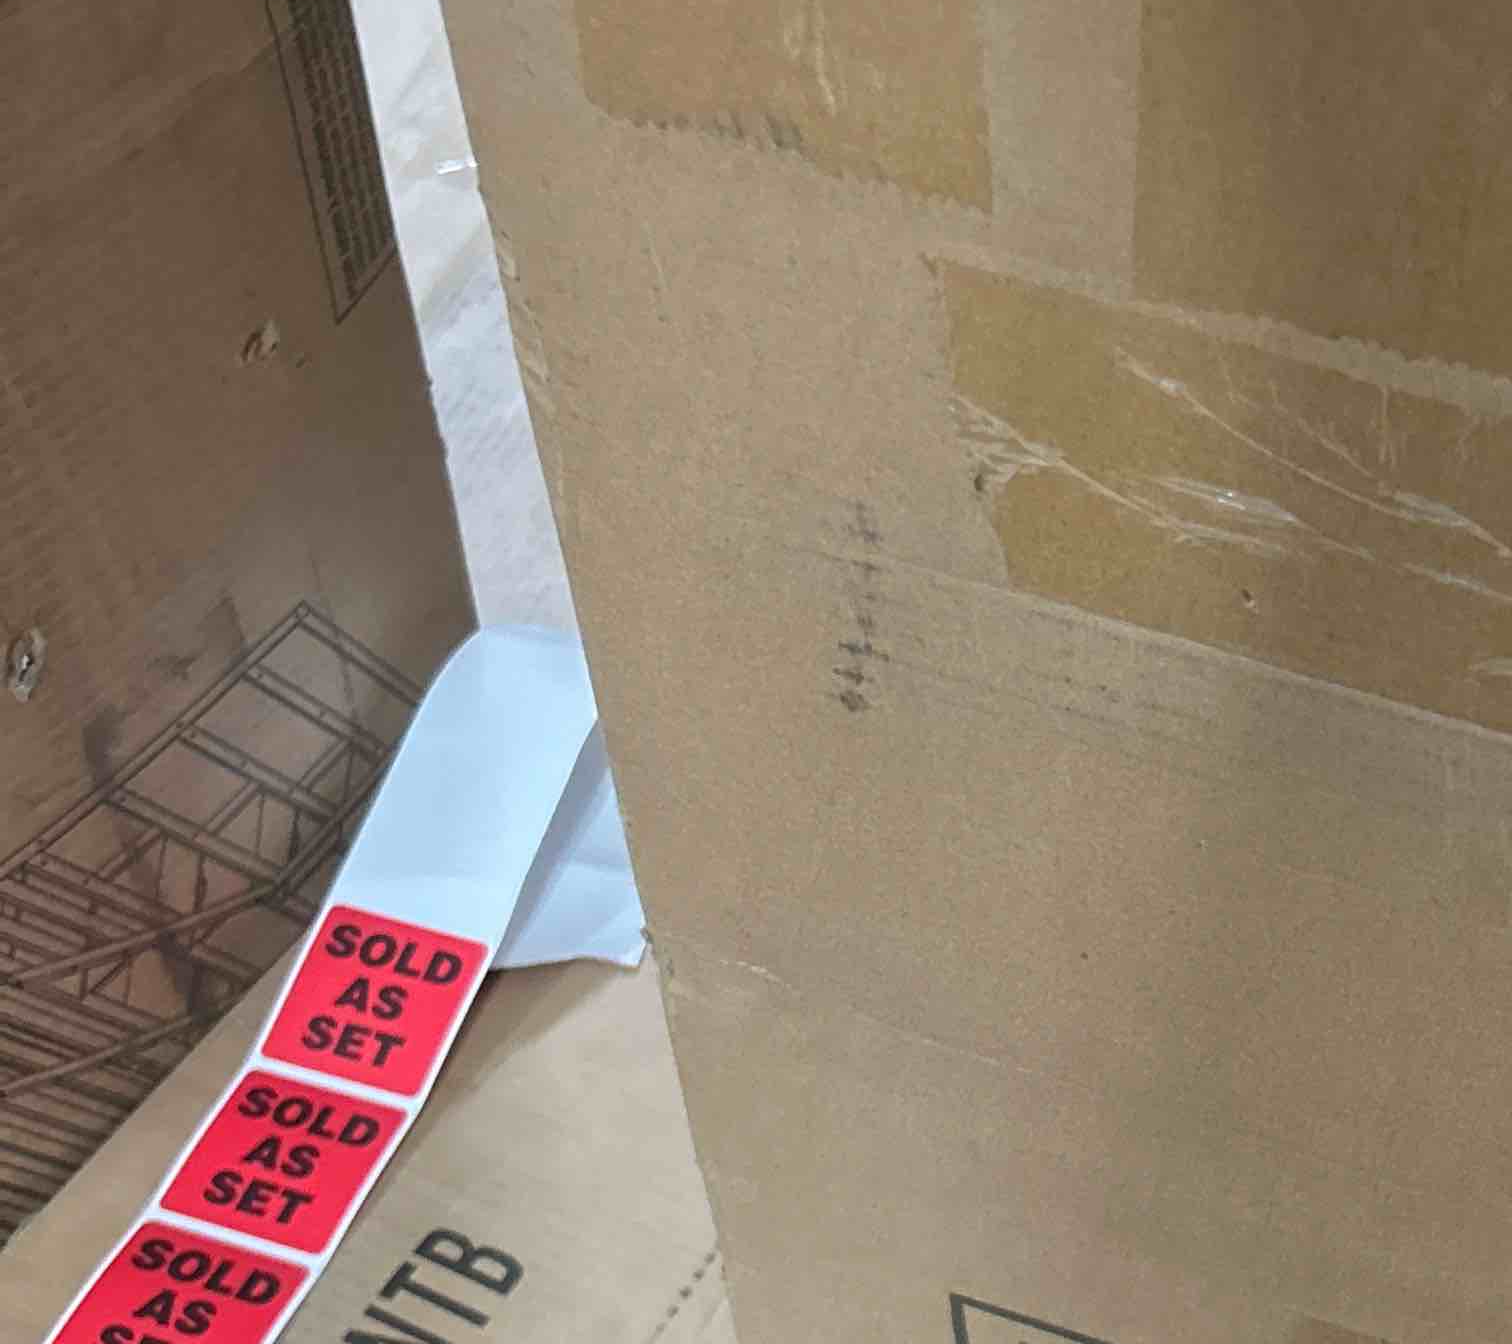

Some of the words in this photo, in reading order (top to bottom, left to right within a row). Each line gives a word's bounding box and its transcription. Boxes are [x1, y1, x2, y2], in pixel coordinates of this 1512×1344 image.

[325, 924, 463, 987] SOLD
[333, 978, 408, 1021] AS
[301, 1016, 408, 1068] SET
[236, 1087, 380, 1149] SOLD
[243, 1136, 321, 1179] AS
[203, 1170, 314, 1225] SET
[130, 1237, 281, 1307] SOLD
[131, 1289, 218, 1338] AS
